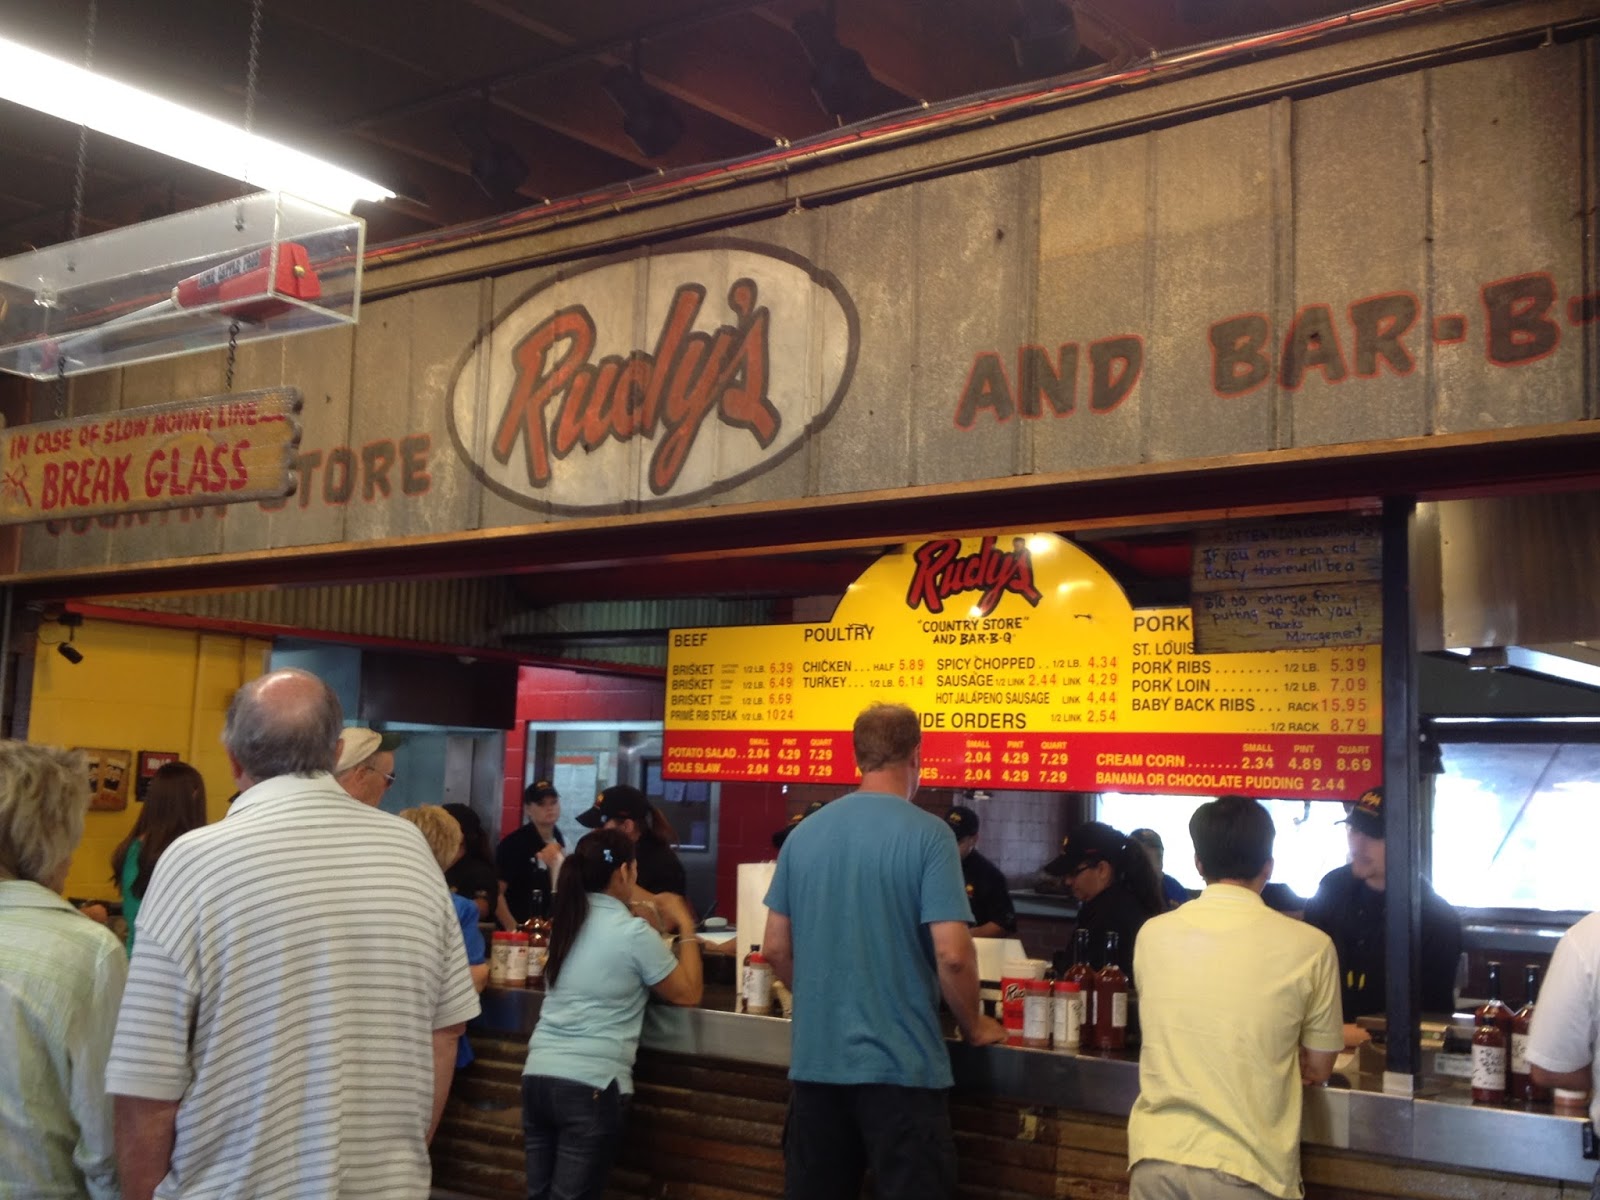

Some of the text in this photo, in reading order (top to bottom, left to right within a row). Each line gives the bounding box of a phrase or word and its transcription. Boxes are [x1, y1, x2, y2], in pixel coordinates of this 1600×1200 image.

[493, 277, 781, 496] Rudy's
[953, 334, 1145, 432] AND
[10, 434, 28, 460] IN
[33, 428, 73, 455] CASE
[78, 425, 100, 447] OF
[103, 417, 147, 445] SLOW
[152, 408, 214, 435] MOVING
[40, 438, 250, 511] BREAK GLASS
[258, 434, 431, 511] TORE
[1223, 549, 1250, 565] you
[1332, 542, 1356, 554] and
[906, 536, 1043, 617] Rudy's
[1212, 608, 1259, 625] putting
[1266, 606, 1284, 620] up
[1133, 615, 1191, 633] PORK
[674, 633, 708, 648] BEEF
[804, 626, 875, 643] POULTRY
[932, 634, 957, 645] AND
[1132, 642, 1195, 656] ST. LOUIS
[672, 664, 715, 676] BRISKET
[769, 662, 794, 674] 6.39
[803, 659, 925, 673] CHICKEN HALF 5.89
[936, 658, 972, 671] SPICY
[974, 657, 1036, 671] CHOPPED
[1053, 660, 1065, 669] 1/2
[1087, 656, 1117, 668] 4.34
[1132, 660, 1172, 674] PORK
[1176, 660, 1211, 674] RIBS
[1284, 664, 1299, 673] 1/2
[1330, 658, 1367, 672] 5.39
[671, 679, 714, 690] BRISKET
[769, 677, 793, 689] 6.49
[802, 676, 847, 688] TURKEY
[869, 679, 881, 688] 1/2
[898, 675, 924, 688] 6.14
[936, 673, 1118, 687] SAUSAGE 1/2 LINK 2.44 LINK 4.29
[1132, 679, 1172, 693] PORK
[1176, 679, 1211, 692] LOIN
[1284, 682, 1299, 692] 1/2
[1330, 677, 1367, 691] 7.09
[671, 694, 713, 706] BRISKET
[935, 692, 953, 705] HOT
[1005, 692, 1050, 705] SAUSAGE
[1062, 695, 1081, 704] LINK
[1087, 691, 1117, 704] 4.44
[1131, 697, 1367, 712] BABY BACK RIBS RACK 15.95
[670, 709, 695, 721] PRIME
[695, 709, 710, 721] RIB
[711, 709, 738, 721] STEAK
[919, 712, 1027, 729] IDE ORDERS
[1051, 709, 1117, 723] 1/2 LINK 2.54
[1271, 718, 1367, 732] 1/2 RACK 8.79
[966, 740, 991, 749] SMALL
[1040, 741, 1068, 750] QUART
[1242, 743, 1370, 754] SMALL PINT QUART
[667, 747, 833, 760] POTATO SALAD 2.04 4.29 7.29
[965, 752, 1069, 765] 2.04 4.29 7.29
[667, 762, 833, 777] COLE SLAW 2.04 4.29 7.29
[1096, 753, 1372, 771] CREAM CORN 2.34 4.89 8.69
[964, 769, 992, 781] 2.04
[1001, 770, 1030, 782] 4.29
[1039, 771, 1068, 783] 7.29
[1095, 771, 1346, 791] BANANA OR CHOCOLATE PUDDING 2.44
